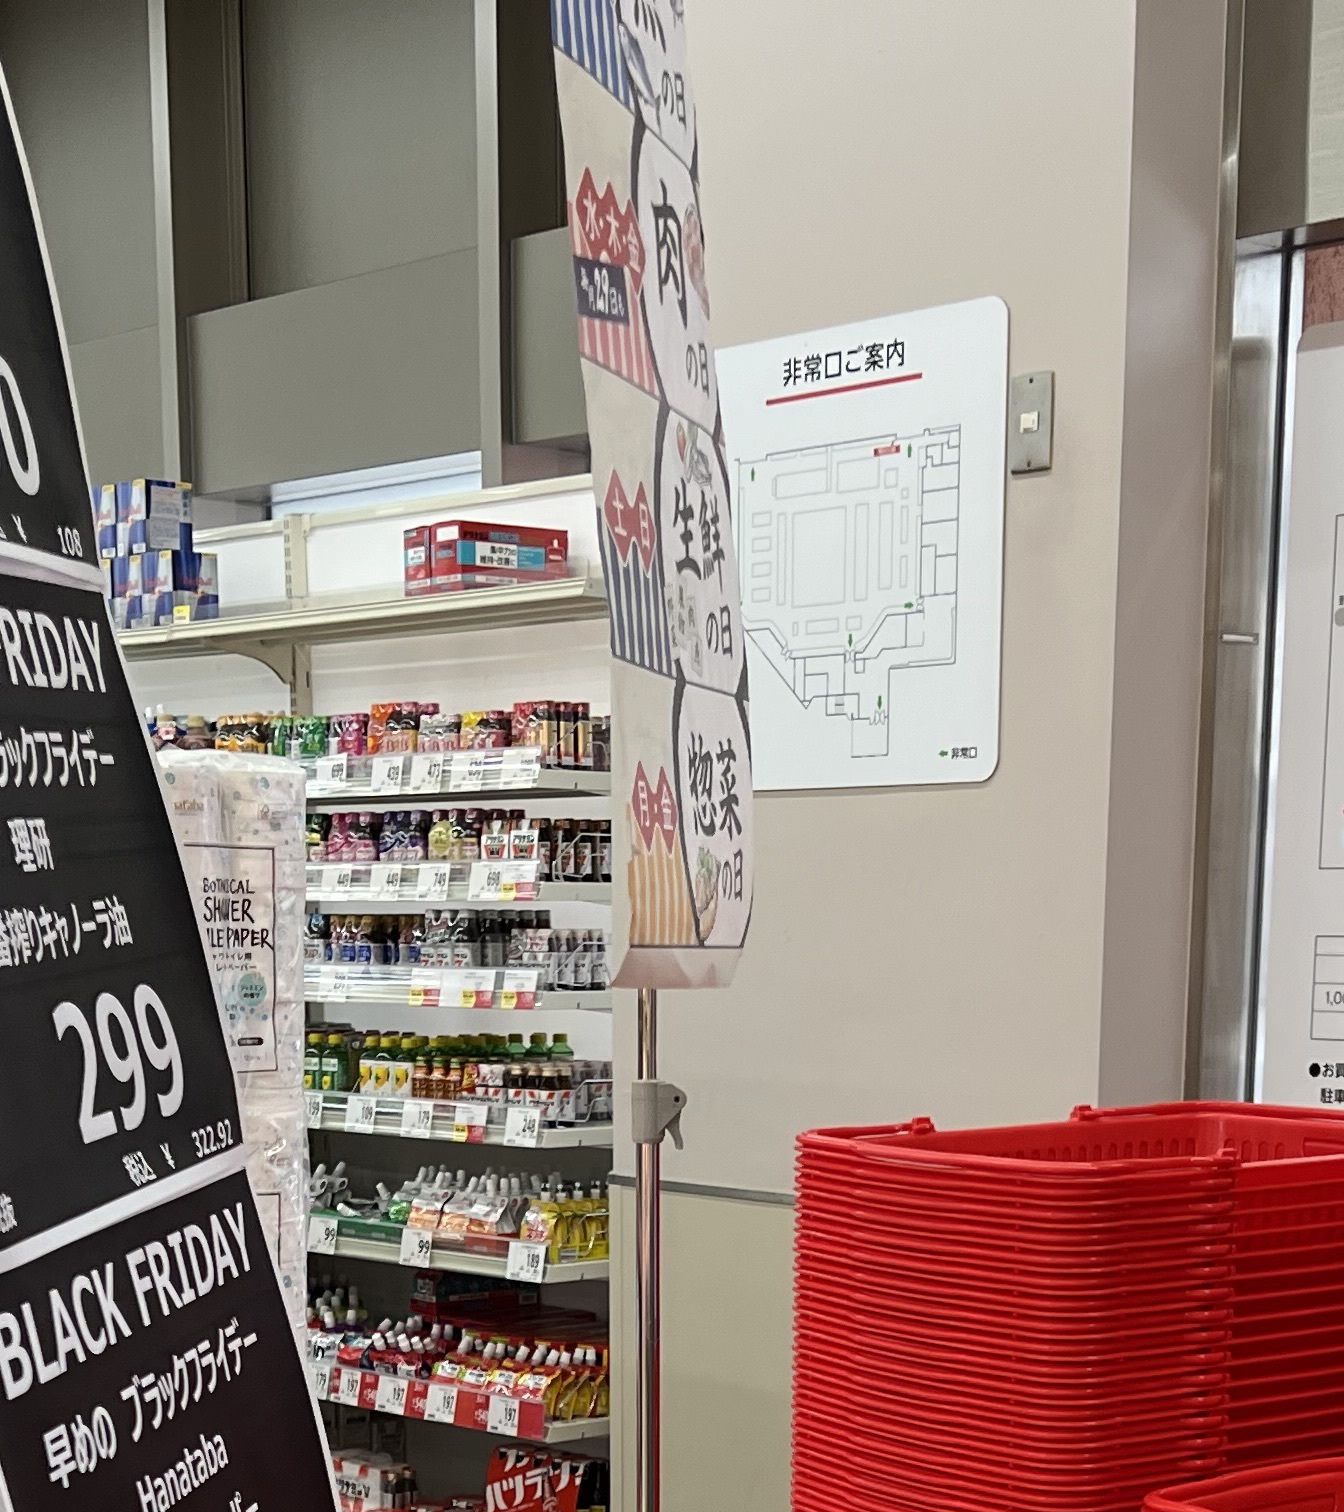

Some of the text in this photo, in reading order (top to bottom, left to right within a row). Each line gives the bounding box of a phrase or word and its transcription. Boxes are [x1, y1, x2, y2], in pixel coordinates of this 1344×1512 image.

[651, 178, 688, 330] 肉
[685, 342, 710, 399] の日
[782, 337, 907, 387] 非常口ご案内
[57, 525, 84, 558] 108
[672, 477, 726, 594] 生鮮
[706, 605, 733, 660] の日
[951, 746, 978, 760] 非常口
[687, 733, 743, 841] 惣菜
[6, 816, 55, 873] 理研
[721, 847, 744, 903] の日
[51, 981, 186, 1146] 299
[121, 1151, 158, 1188] 税込
[191, 1118, 236, 1159] 322.92
[323, 1226, 336, 1242] 99
[418, 1238, 431, 1255] 99
[126, 1201, 256, 1329] FRIDAY
[42, 1314, 259, 1491] 早めの ブラックフライデー
